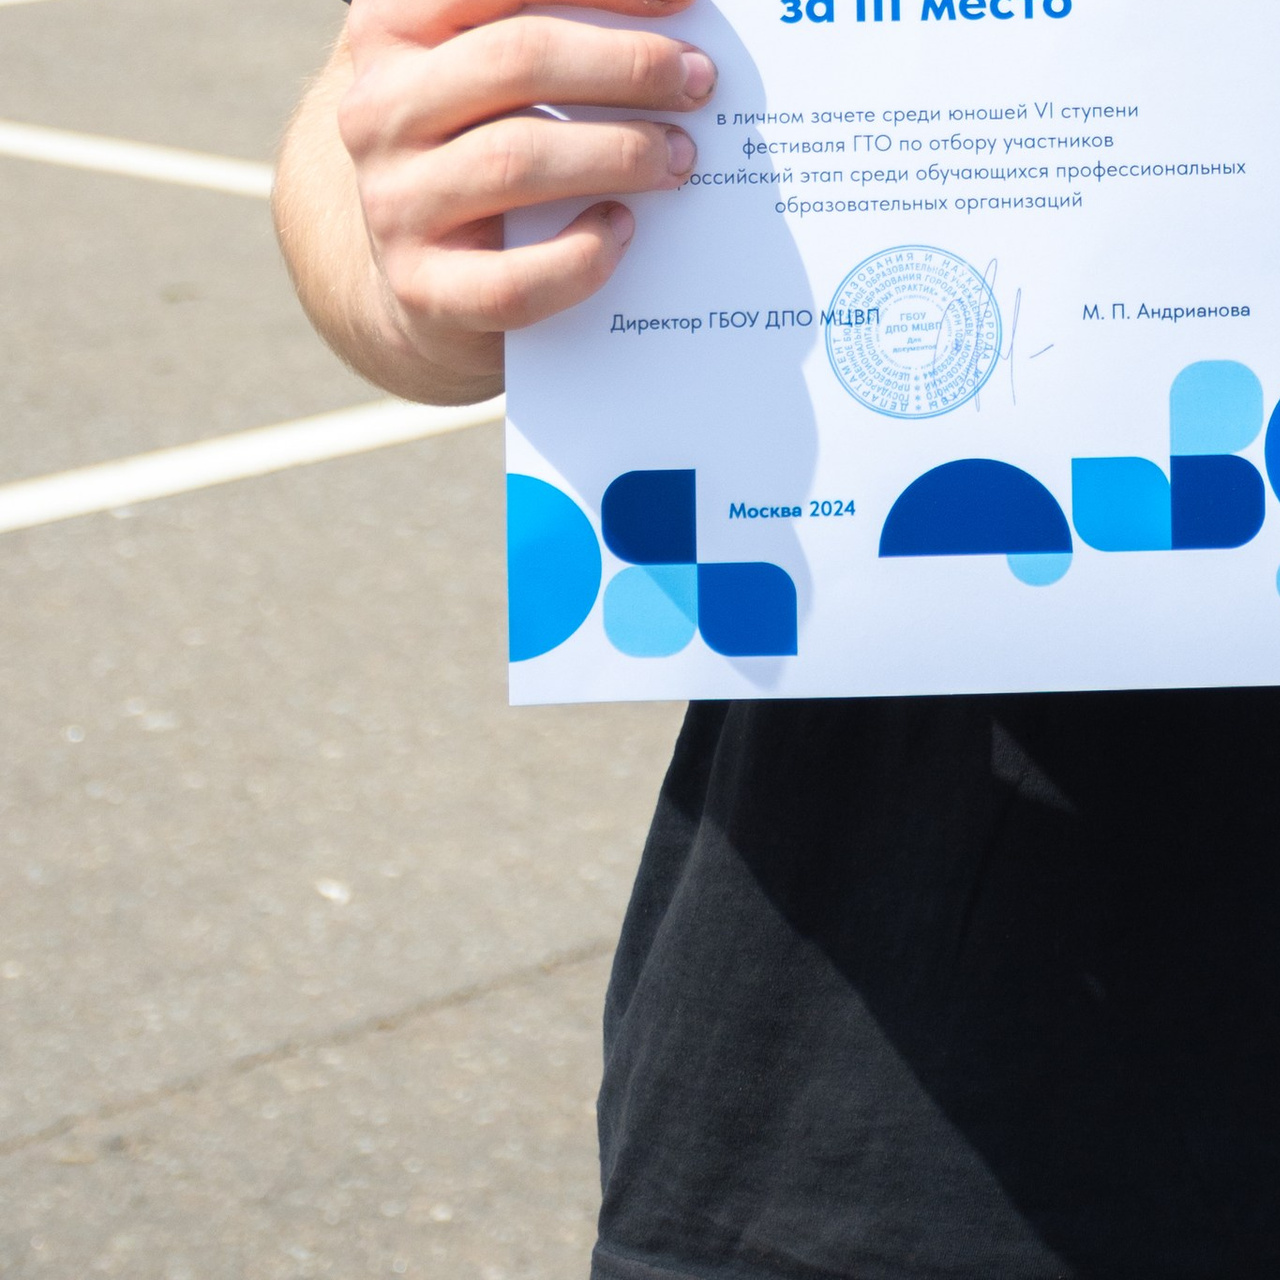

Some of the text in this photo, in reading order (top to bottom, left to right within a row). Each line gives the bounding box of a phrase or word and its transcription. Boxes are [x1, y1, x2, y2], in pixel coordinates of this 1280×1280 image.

[717, 102, 1138, 127] в личном зачете среди юношей VI ступени
[743, 133, 1114, 159] фестиваля ГТО по отбору участников
[678, 160, 1245, 191] оссийский этап среди обучающихся профессиональных
[775, 192, 1082, 218] образовательных организаций
[610, 303, 1250, 335] Директор ГБОУ ДПО МЦВП М. П. Андрианова
[900, 312, 926, 321] ГБОУ
[729, 500, 855, 519] Москва 2024
